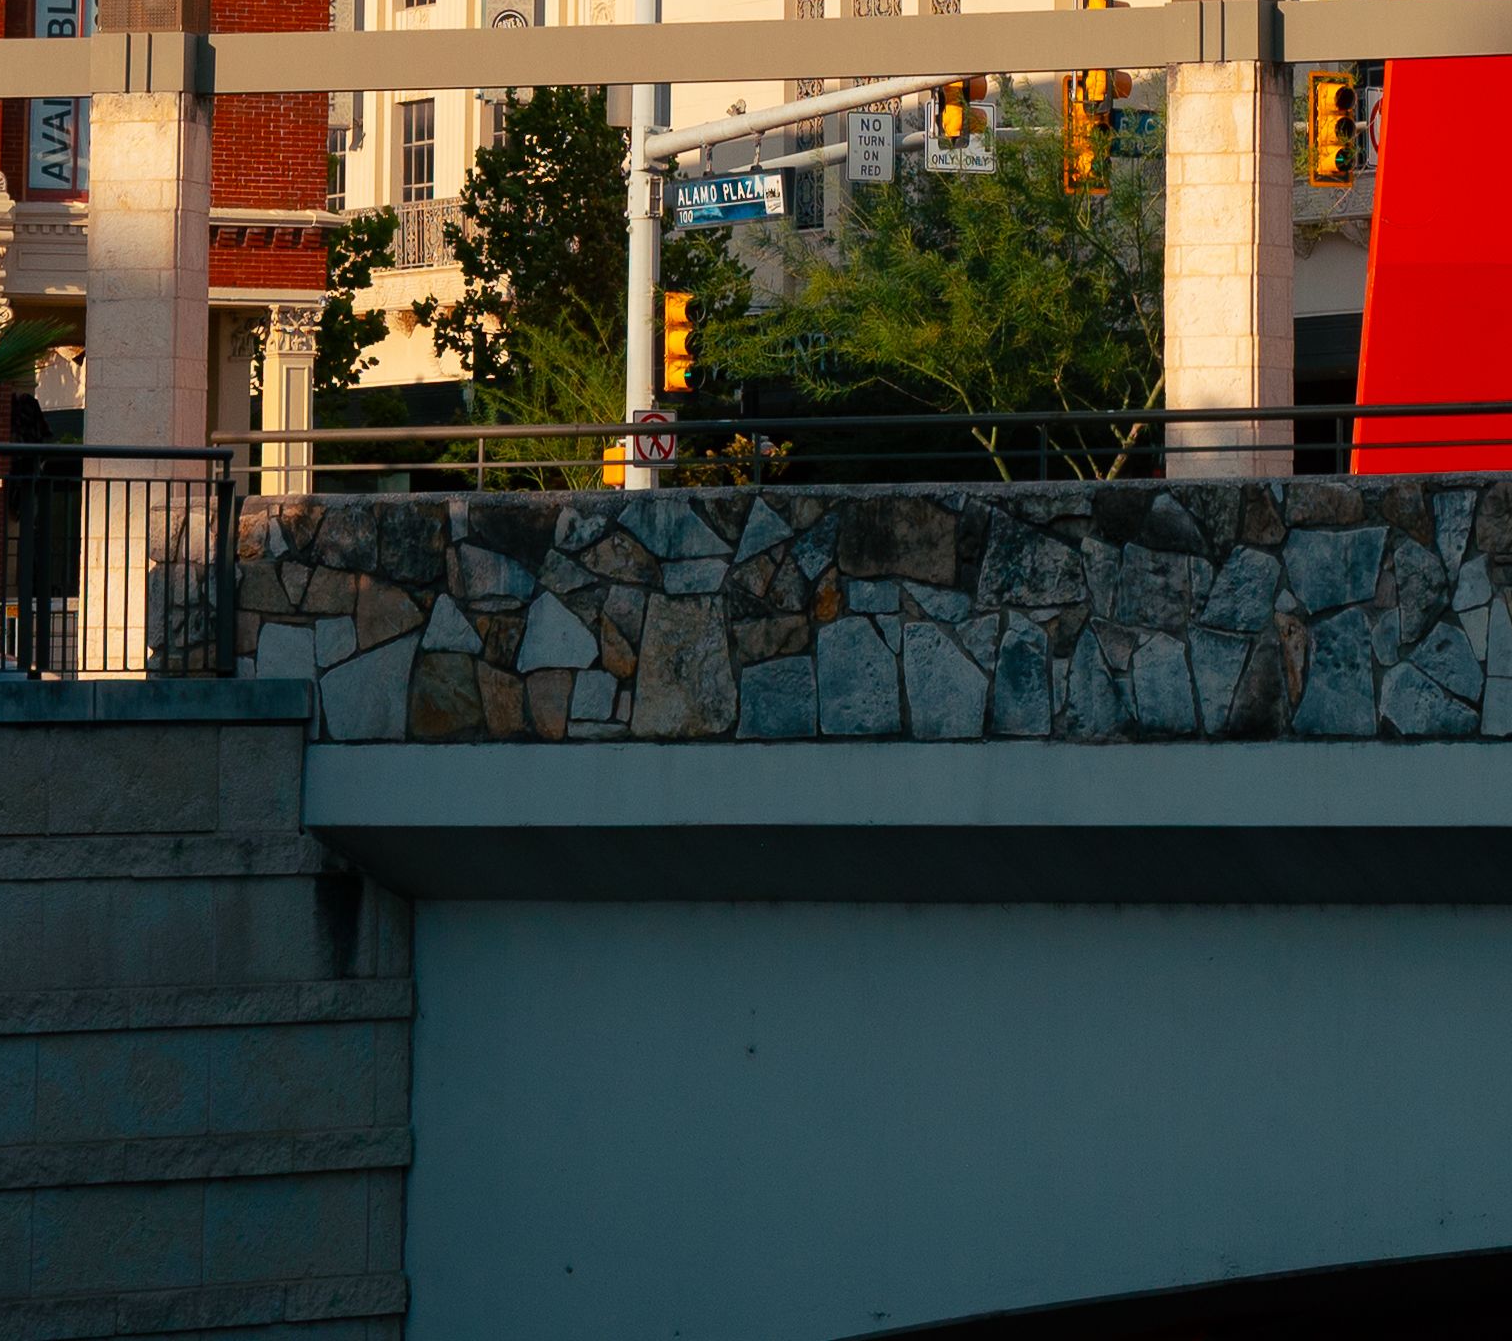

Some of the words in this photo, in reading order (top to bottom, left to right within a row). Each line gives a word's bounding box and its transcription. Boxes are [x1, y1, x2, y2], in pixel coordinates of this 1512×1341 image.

[861, 118, 882, 132] NO
[858, 136, 885, 146] TURN
[863, 150, 879, 161] ON
[932, 155, 955, 165] ONLY
[965, 156, 990, 167] ONLY
[861, 165, 881, 176] RED
[678, 184, 718, 206] ALAMO
[722, 175, 764, 201] PLAZA
[679, 210, 694, 224] 100
